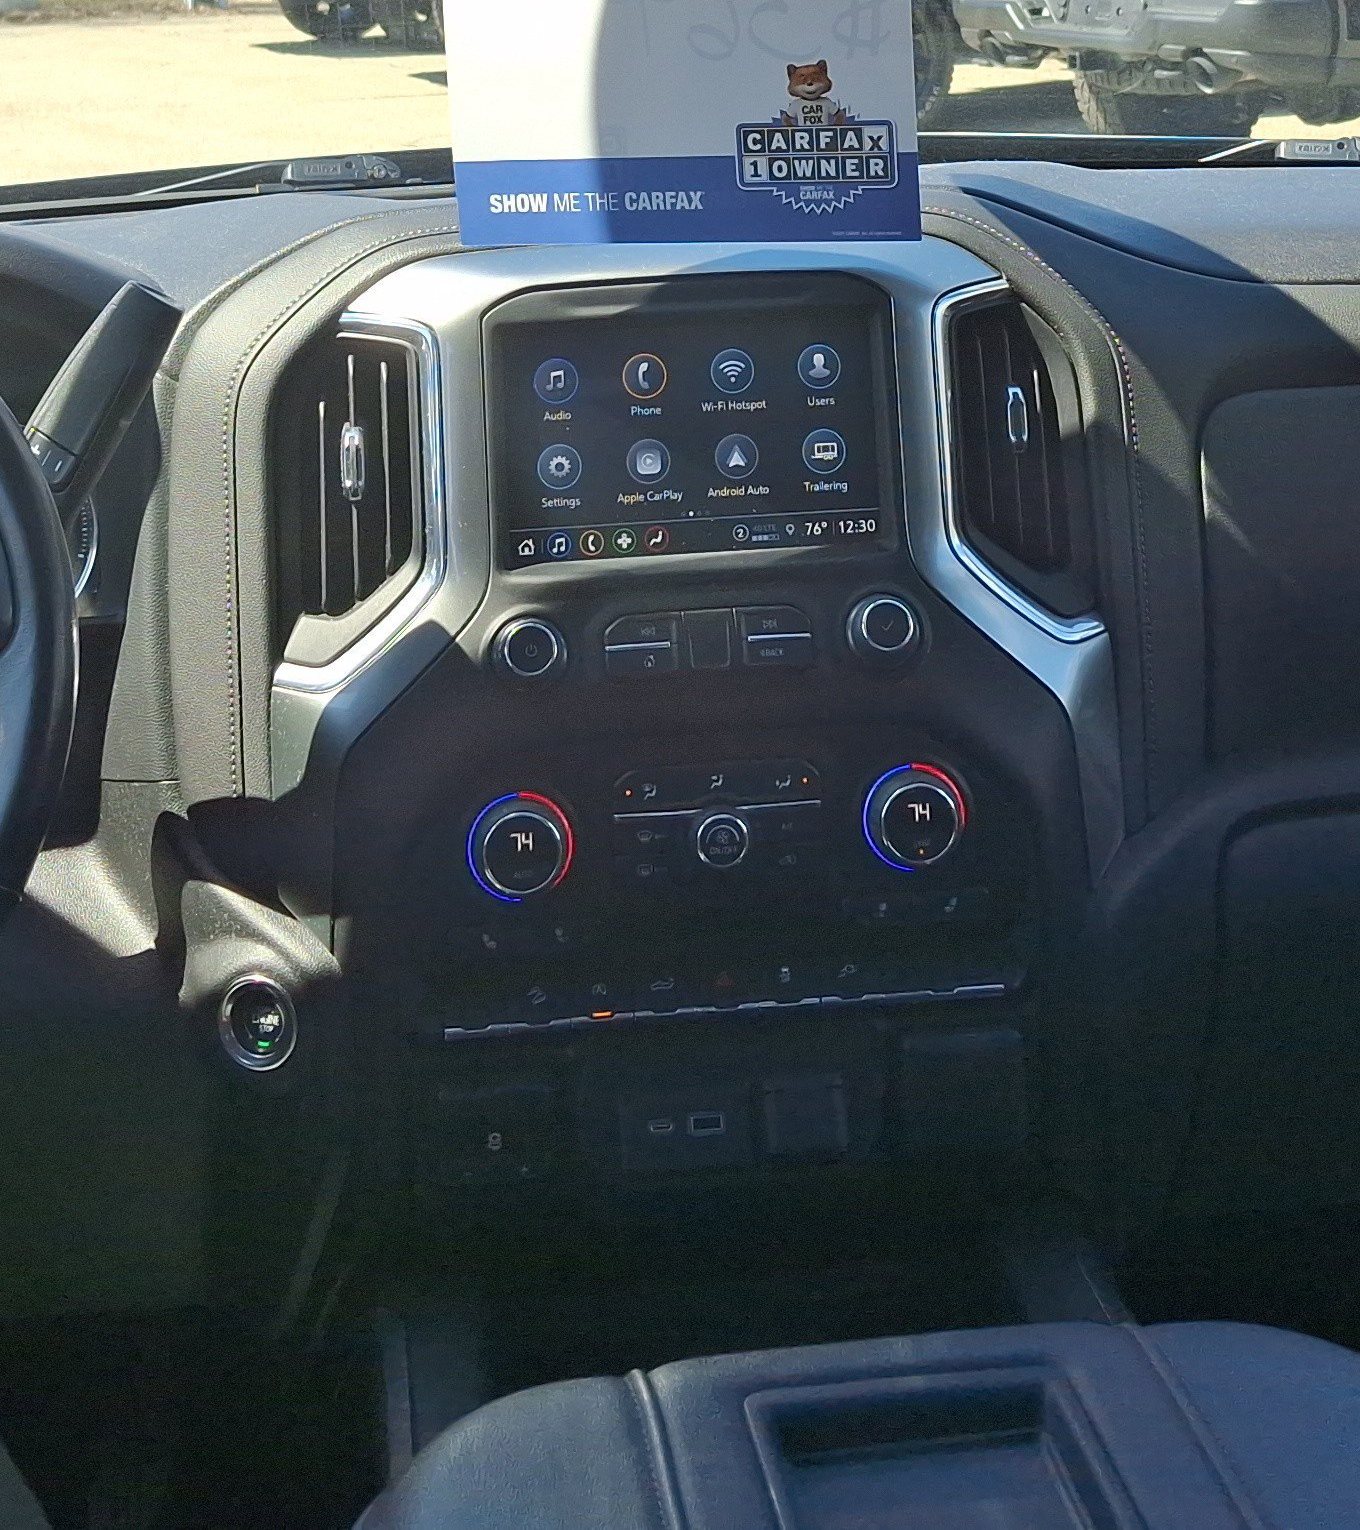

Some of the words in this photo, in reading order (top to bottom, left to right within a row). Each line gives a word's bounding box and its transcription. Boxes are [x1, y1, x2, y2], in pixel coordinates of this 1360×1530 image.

[801, 104, 823, 115] CAR
[803, 115, 824, 125] FOX
[747, 131, 884, 152] CARFAX
[800, 190, 835, 200] CARFAX
[490, 193, 548, 213] SHOW
[553, 192, 581, 212] ME
[584, 192, 620, 212] THE
[624, 191, 703, 211] CARFAX
[701, 400, 727, 413] Wi-Fi
[728, 399, 767, 413] Hotspot
[807, 396, 835, 407] Users
[544, 410, 572, 422] Audio
[631, 405, 662, 417] Phone
[708, 485, 746, 497] Android
[747, 484, 770, 496] Auto
[803, 480, 849, 494] Trailering
[541, 496, 582, 509] Settings
[617, 492, 645, 505] Apple
[646, 489, 683, 504] CarPlay
[805, 522, 828, 536] 76°
[839, 520, 877, 535] 12:30
[907, 803, 930, 822] 74
[510, 832, 533, 852] 74
